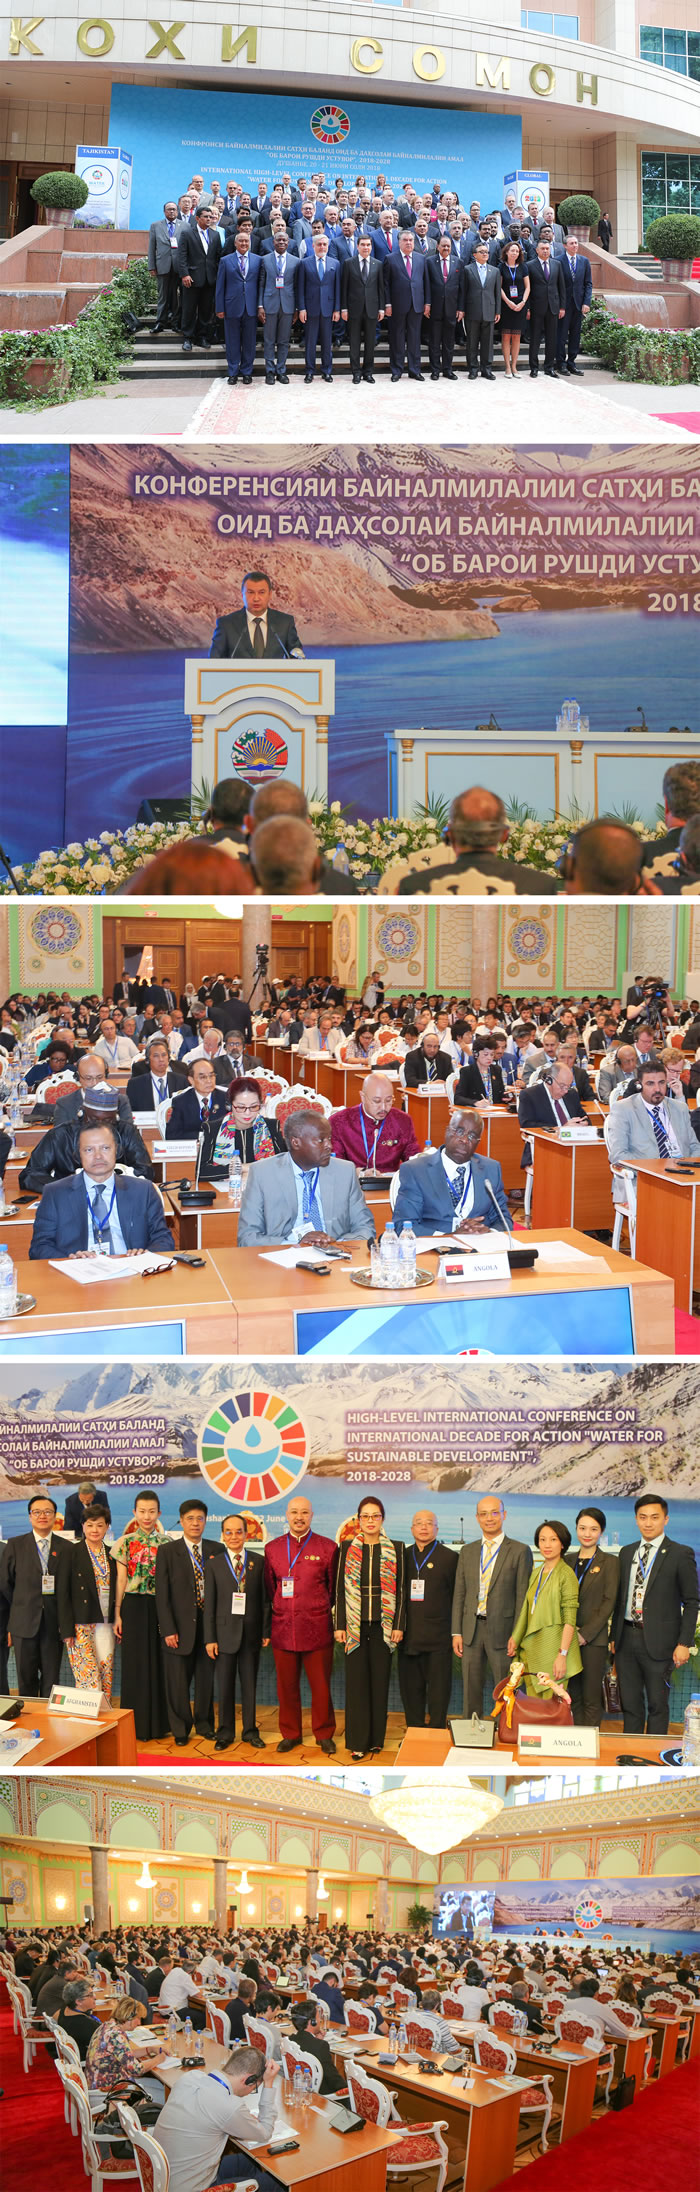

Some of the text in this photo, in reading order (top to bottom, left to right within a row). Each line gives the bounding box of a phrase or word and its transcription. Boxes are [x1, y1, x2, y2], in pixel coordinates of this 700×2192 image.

[8, 17, 598, 106] КОХИ СОМОН
[200, 166, 253, 175] INTERNATIONAL
[134, 474, 336, 497] КОНФЕРЕНСИЯИ
[343, 475, 575, 498] БАЙНАЛМИЛАЛИИ
[582, 478, 663, 502] САТҲИ
[217, 512, 694, 540] ОИД БА ДАҲСОЛАИ БАЙНАЛМИЛАЛИИ
[452, 554, 536, 574] БАРОИ
[544, 554, 635, 578] РУШДИ
[473, 1264, 498, 1272] ANGOLA
[347, 1410, 635, 1424] HIGH-LEVEL INTERNATIONAL CONFERENCE ON
[82, 1420, 117, 1432] САТҲИ
[119, 1419, 165, 1431] БАЛАНД
[347, 1430, 664, 1443] INTERNATIONAL DECADE FOR ACTION "WATER FOR
[32, 1438, 130, 1451] БАЙНАЛМИЛАЛИИ
[132, 1437, 165, 1448] АМАЛ
[30, 1458, 65, 1469] БАРОИ
[67, 1457, 106, 1469] РУШДИ
[347, 1451, 537, 1463] SUSTAINABLE DEVELOPMENT",
[109, 1474, 165, 1485] 2018-2028
[347, 1471, 411, 1482] 2018-2028
[266, 1515, 286, 1523] June
[66, 1698, 98, 1707] AFGHANISTAN
[552, 1739, 582, 1747] ANGOLA
